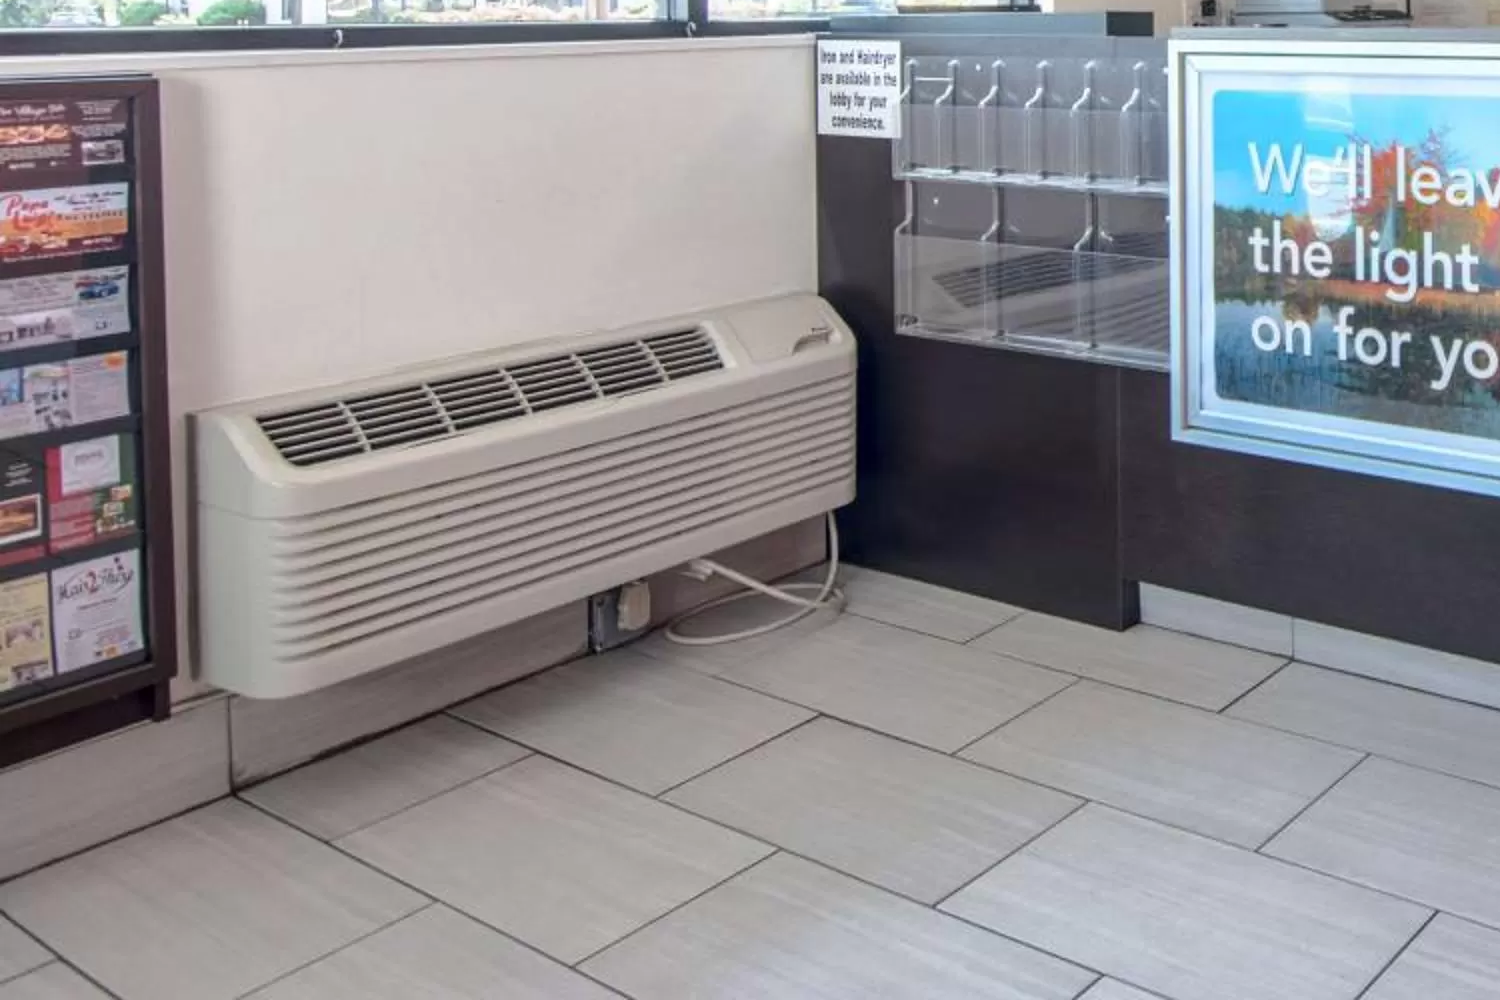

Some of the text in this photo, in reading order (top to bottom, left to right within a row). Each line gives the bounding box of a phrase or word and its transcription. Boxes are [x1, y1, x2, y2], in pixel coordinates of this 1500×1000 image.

[839, 49, 855, 64] and
[820, 70, 897, 87] are available in the
[830, 90, 887, 112] lobby for your
[1247, 141, 1373, 201] We'll
[1248, 219, 1481, 302] the light
[1251, 316, 1312, 357] on
[1333, 306, 1413, 369] for
